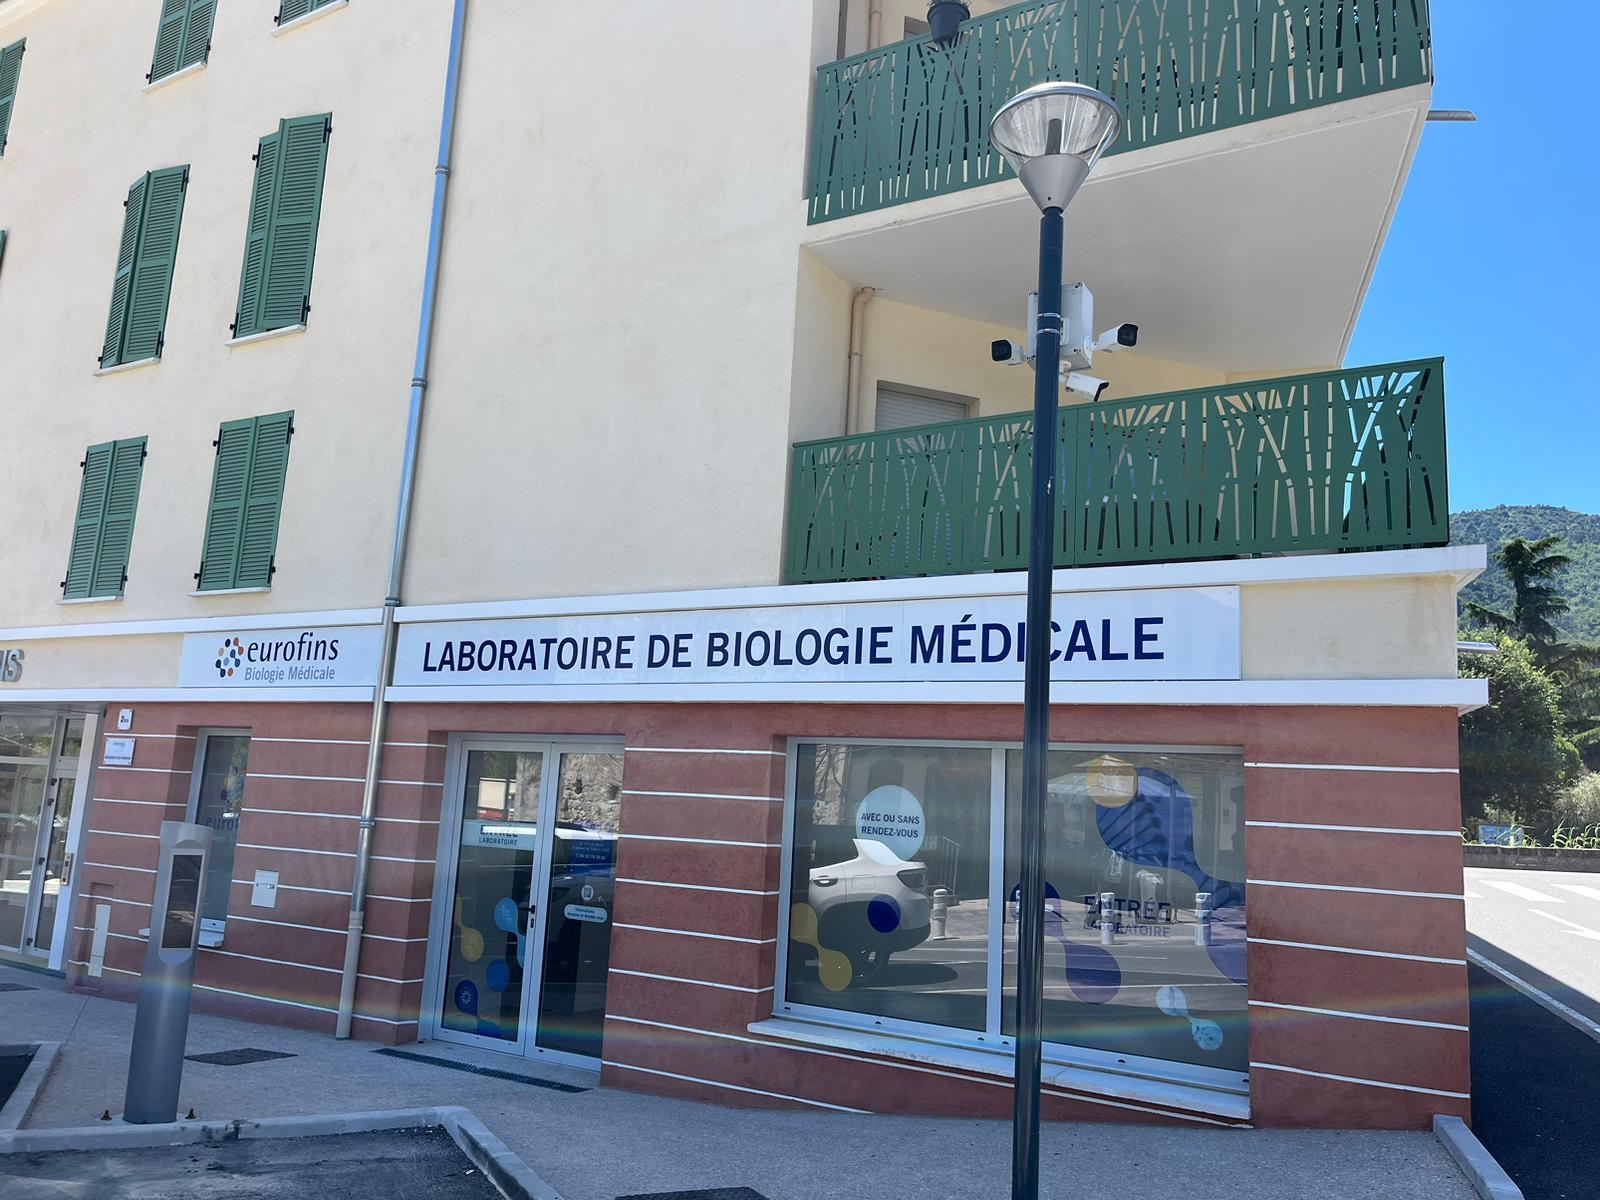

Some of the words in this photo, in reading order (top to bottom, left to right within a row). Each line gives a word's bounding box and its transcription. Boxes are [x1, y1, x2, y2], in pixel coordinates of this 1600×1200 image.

[247, 632, 339, 662] eurofins
[423, 635, 635, 672] LABORATOIRE
[647, 633, 693, 669] DE
[707, 626, 893, 667] BIOLOGIE
[910, 614, 1164, 664] MÉDICALE
[245, 666, 284, 683] Biologie
[288, 665, 336, 680] Médicale
[861, 812, 881, 822] AVEC
[883, 814, 895, 823] OU
[897, 814, 920, 825] SANS
[861, 825, 919, 838] RENDEZ-VOUS
[478, 836, 519, 846] LABORATOIRE
[1084, 920, 1171, 937] LAORATOIRE
